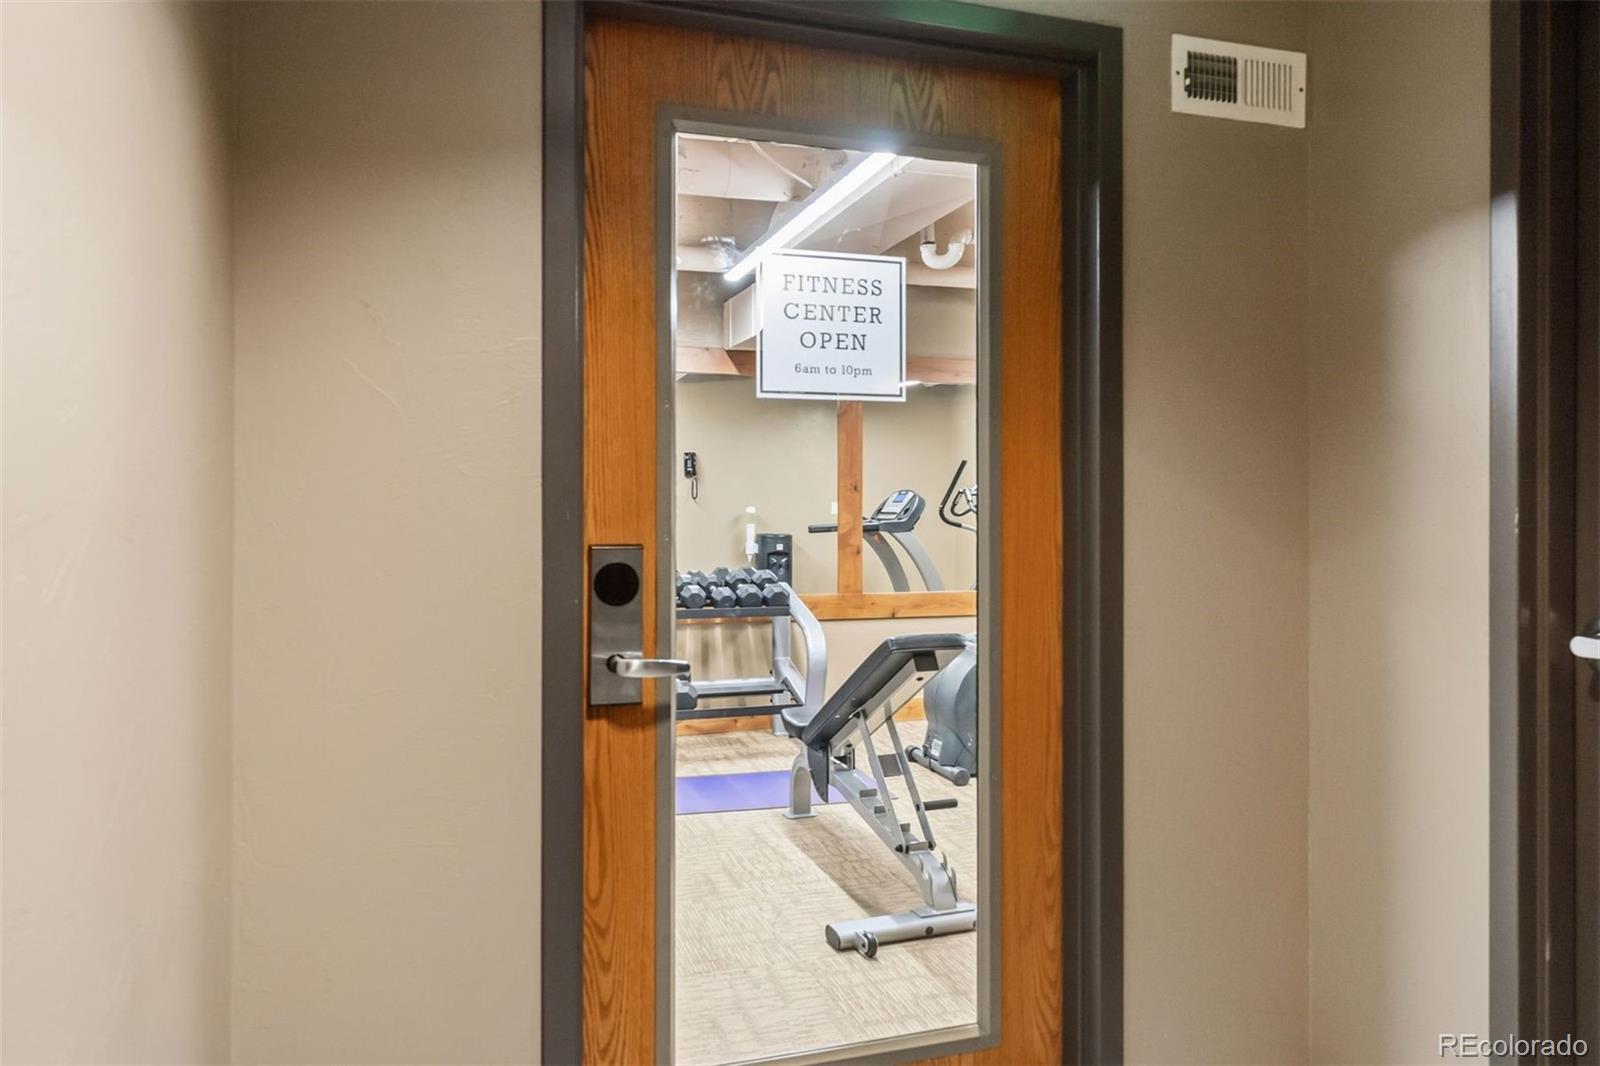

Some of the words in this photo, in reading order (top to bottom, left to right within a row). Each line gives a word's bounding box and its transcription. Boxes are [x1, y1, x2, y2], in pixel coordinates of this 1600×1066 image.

[783, 274, 883, 297] FITNESS
[783, 302, 883, 325] CENTER
[800, 331, 868, 351] OPEN
[794, 363, 821, 375] 6am
[825, 364, 837, 375] to
[841, 365, 873, 378] 10pm
